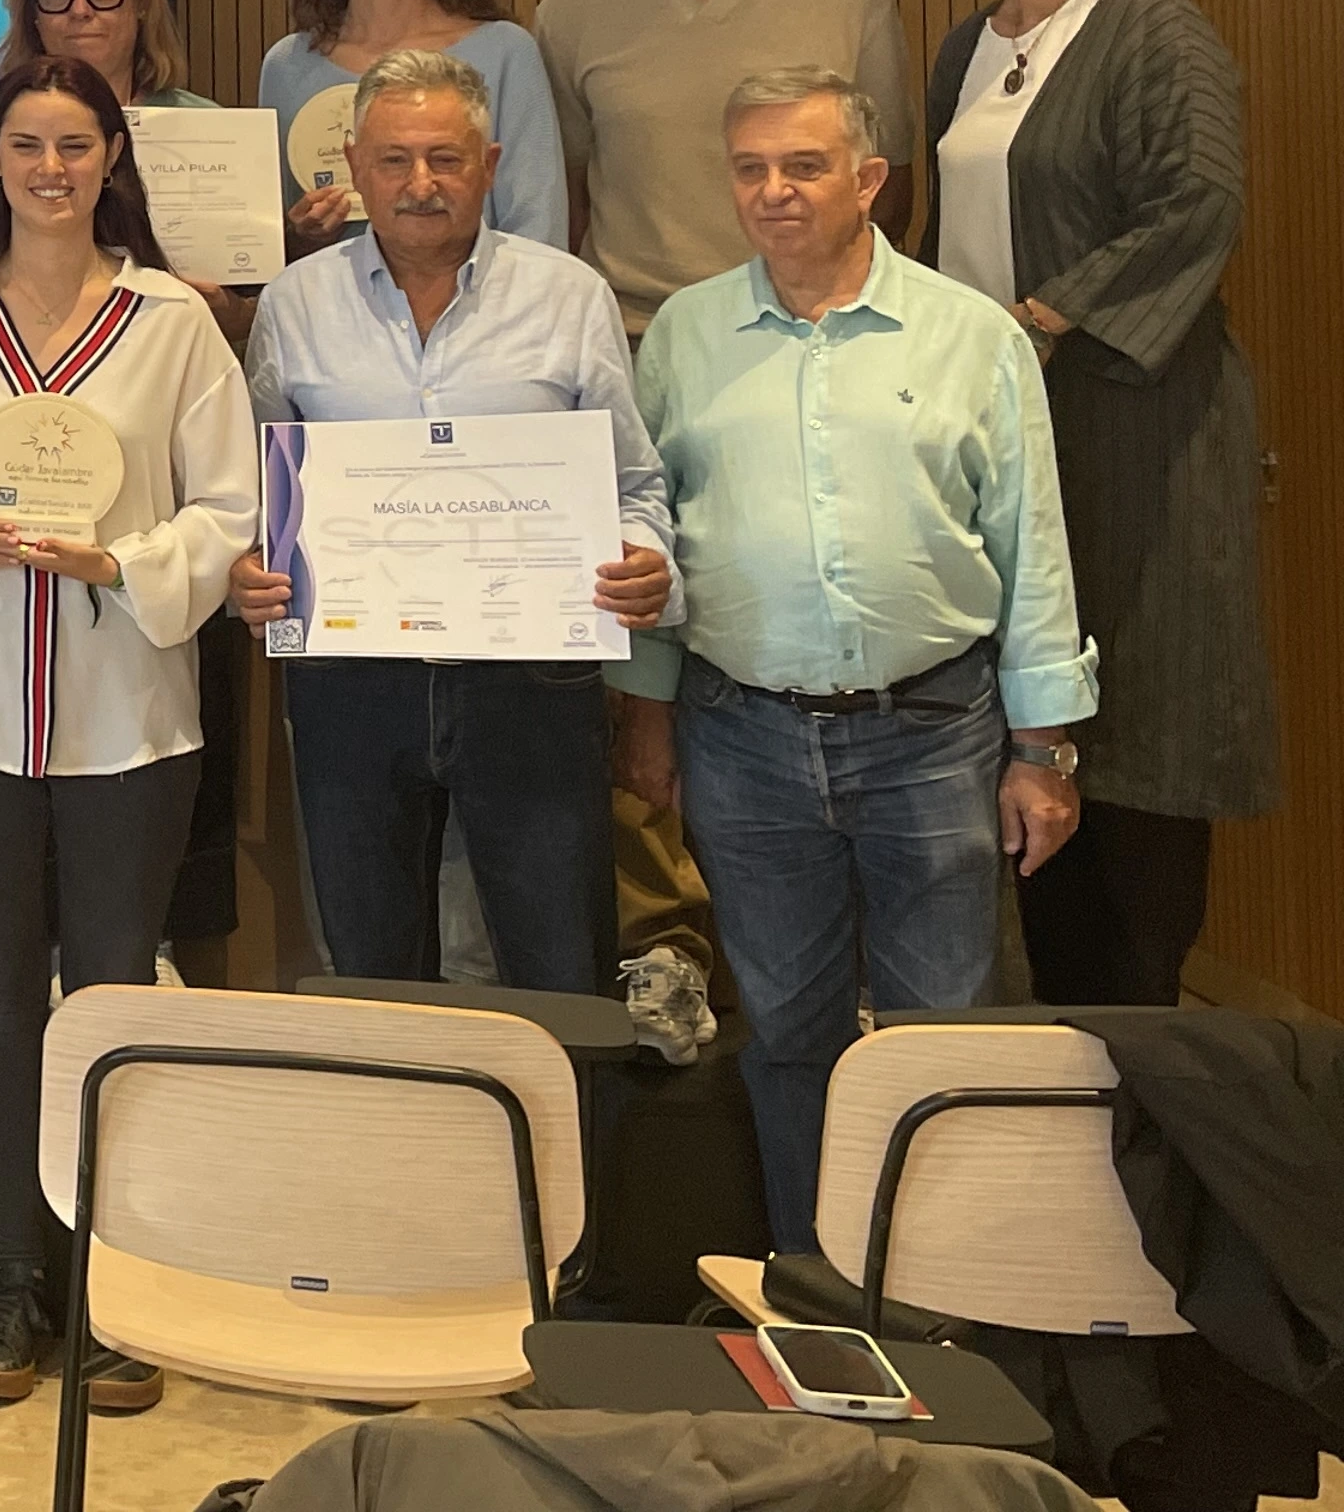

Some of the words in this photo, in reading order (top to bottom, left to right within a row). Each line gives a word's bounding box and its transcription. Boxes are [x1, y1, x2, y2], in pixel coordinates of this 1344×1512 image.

[149, 163, 186, 173] VILLA
[189, 163, 228, 173] PILAR
[373, 499, 421, 515] MASÍA
[424, 501, 444, 514] LA
[447, 499, 552, 514] CASABLANCA
